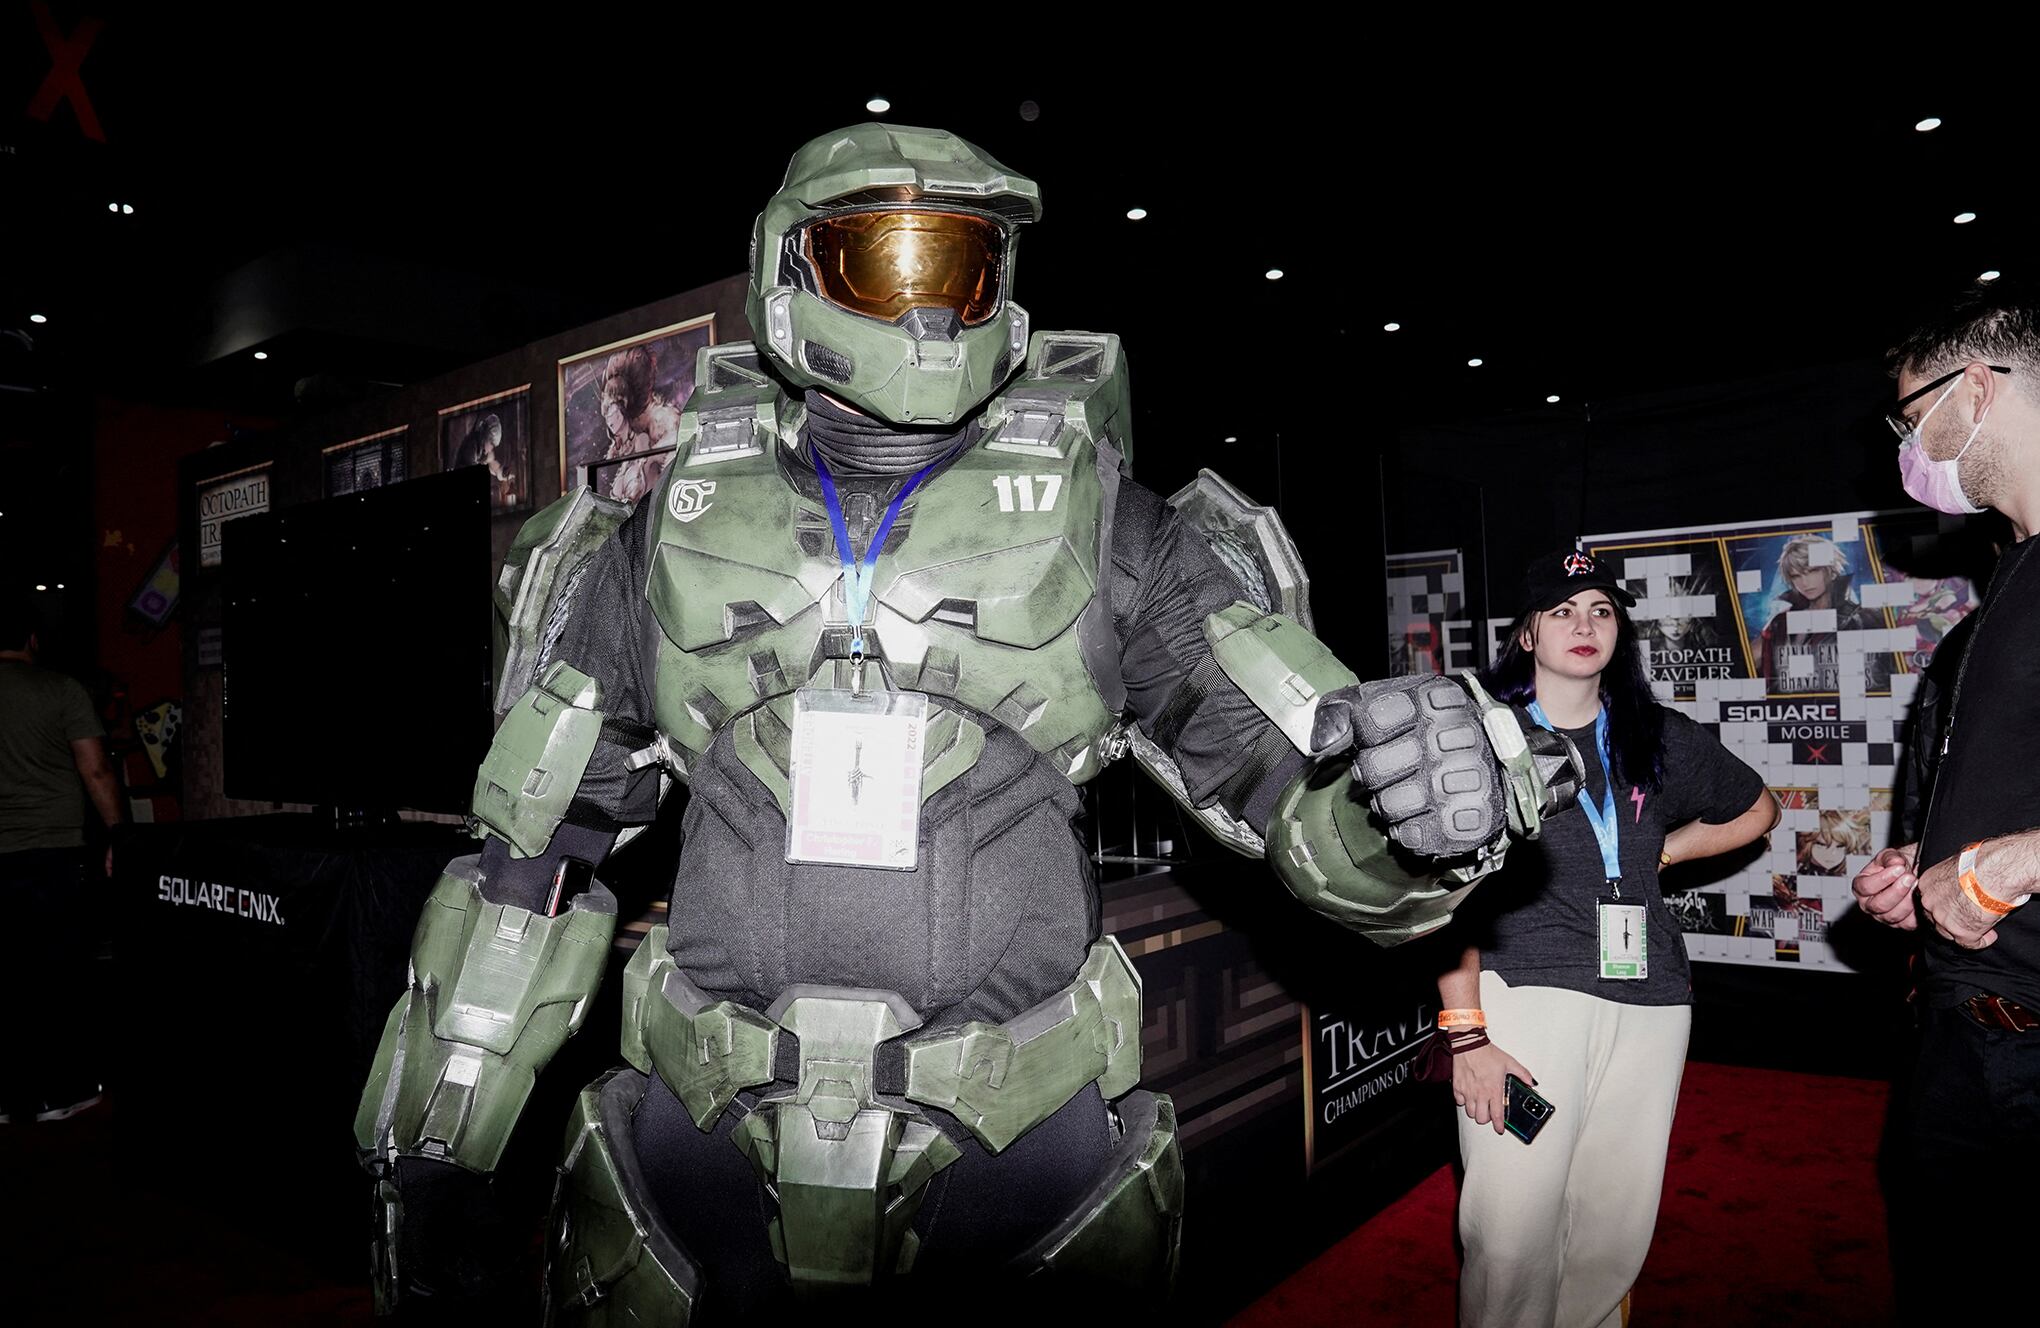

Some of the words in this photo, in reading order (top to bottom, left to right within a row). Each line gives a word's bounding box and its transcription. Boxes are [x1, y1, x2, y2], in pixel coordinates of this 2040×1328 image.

[201, 480, 266, 517] OCTOPATH
[992, 475, 1062, 512] 117
[1650, 647, 1731, 664] CTOPATH
[1650, 666, 1732, 681] RAVELER
[1727, 704, 1837, 722] SQUARE
[907, 722, 918, 750] 2022
[1781, 725, 1850, 740] MOBILE
[158, 875, 235, 914] SQUARE
[1751, 909, 1775, 929] WAR
[1799, 910, 1820, 931] THE
[1323, 1070, 1394, 1125] CHAMPIONS
[1394, 1060, 1410, 1085] OF
